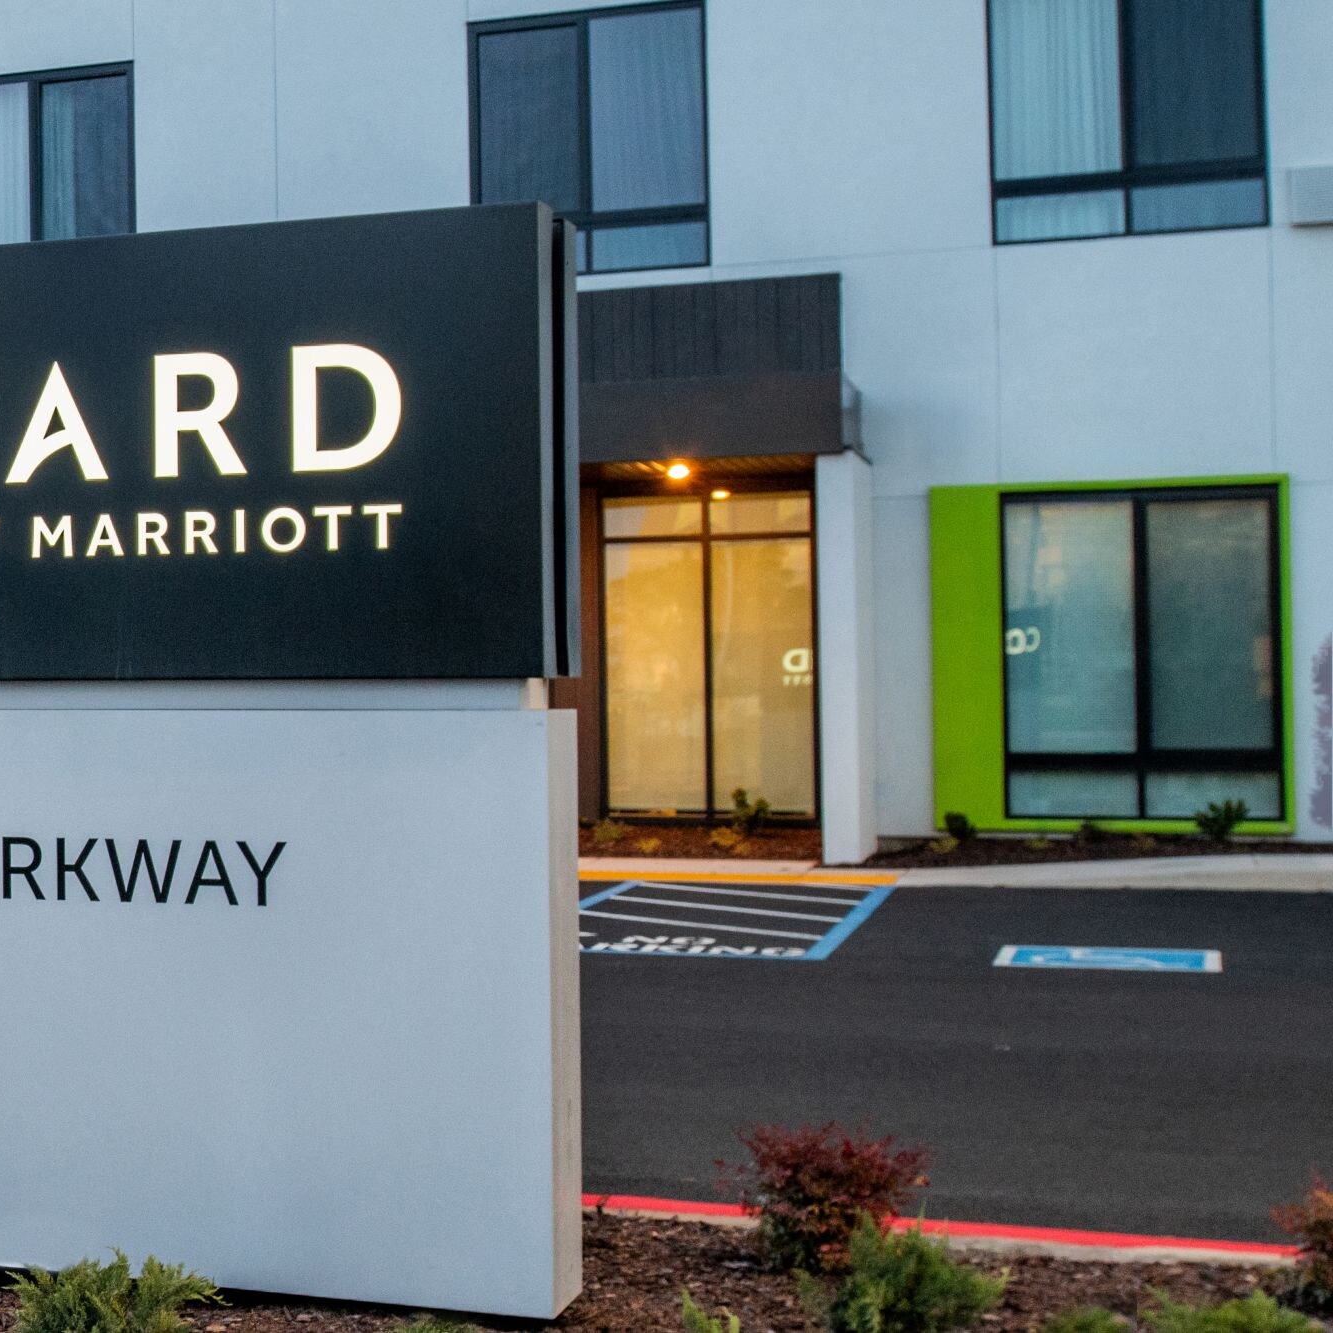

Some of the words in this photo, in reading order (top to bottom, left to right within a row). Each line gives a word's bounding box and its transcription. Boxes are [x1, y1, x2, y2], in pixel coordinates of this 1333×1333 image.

[31, 503, 403, 559] MARRIOTT
[621, 935, 716, 945] NO
[579, 942, 806, 957] RKING
